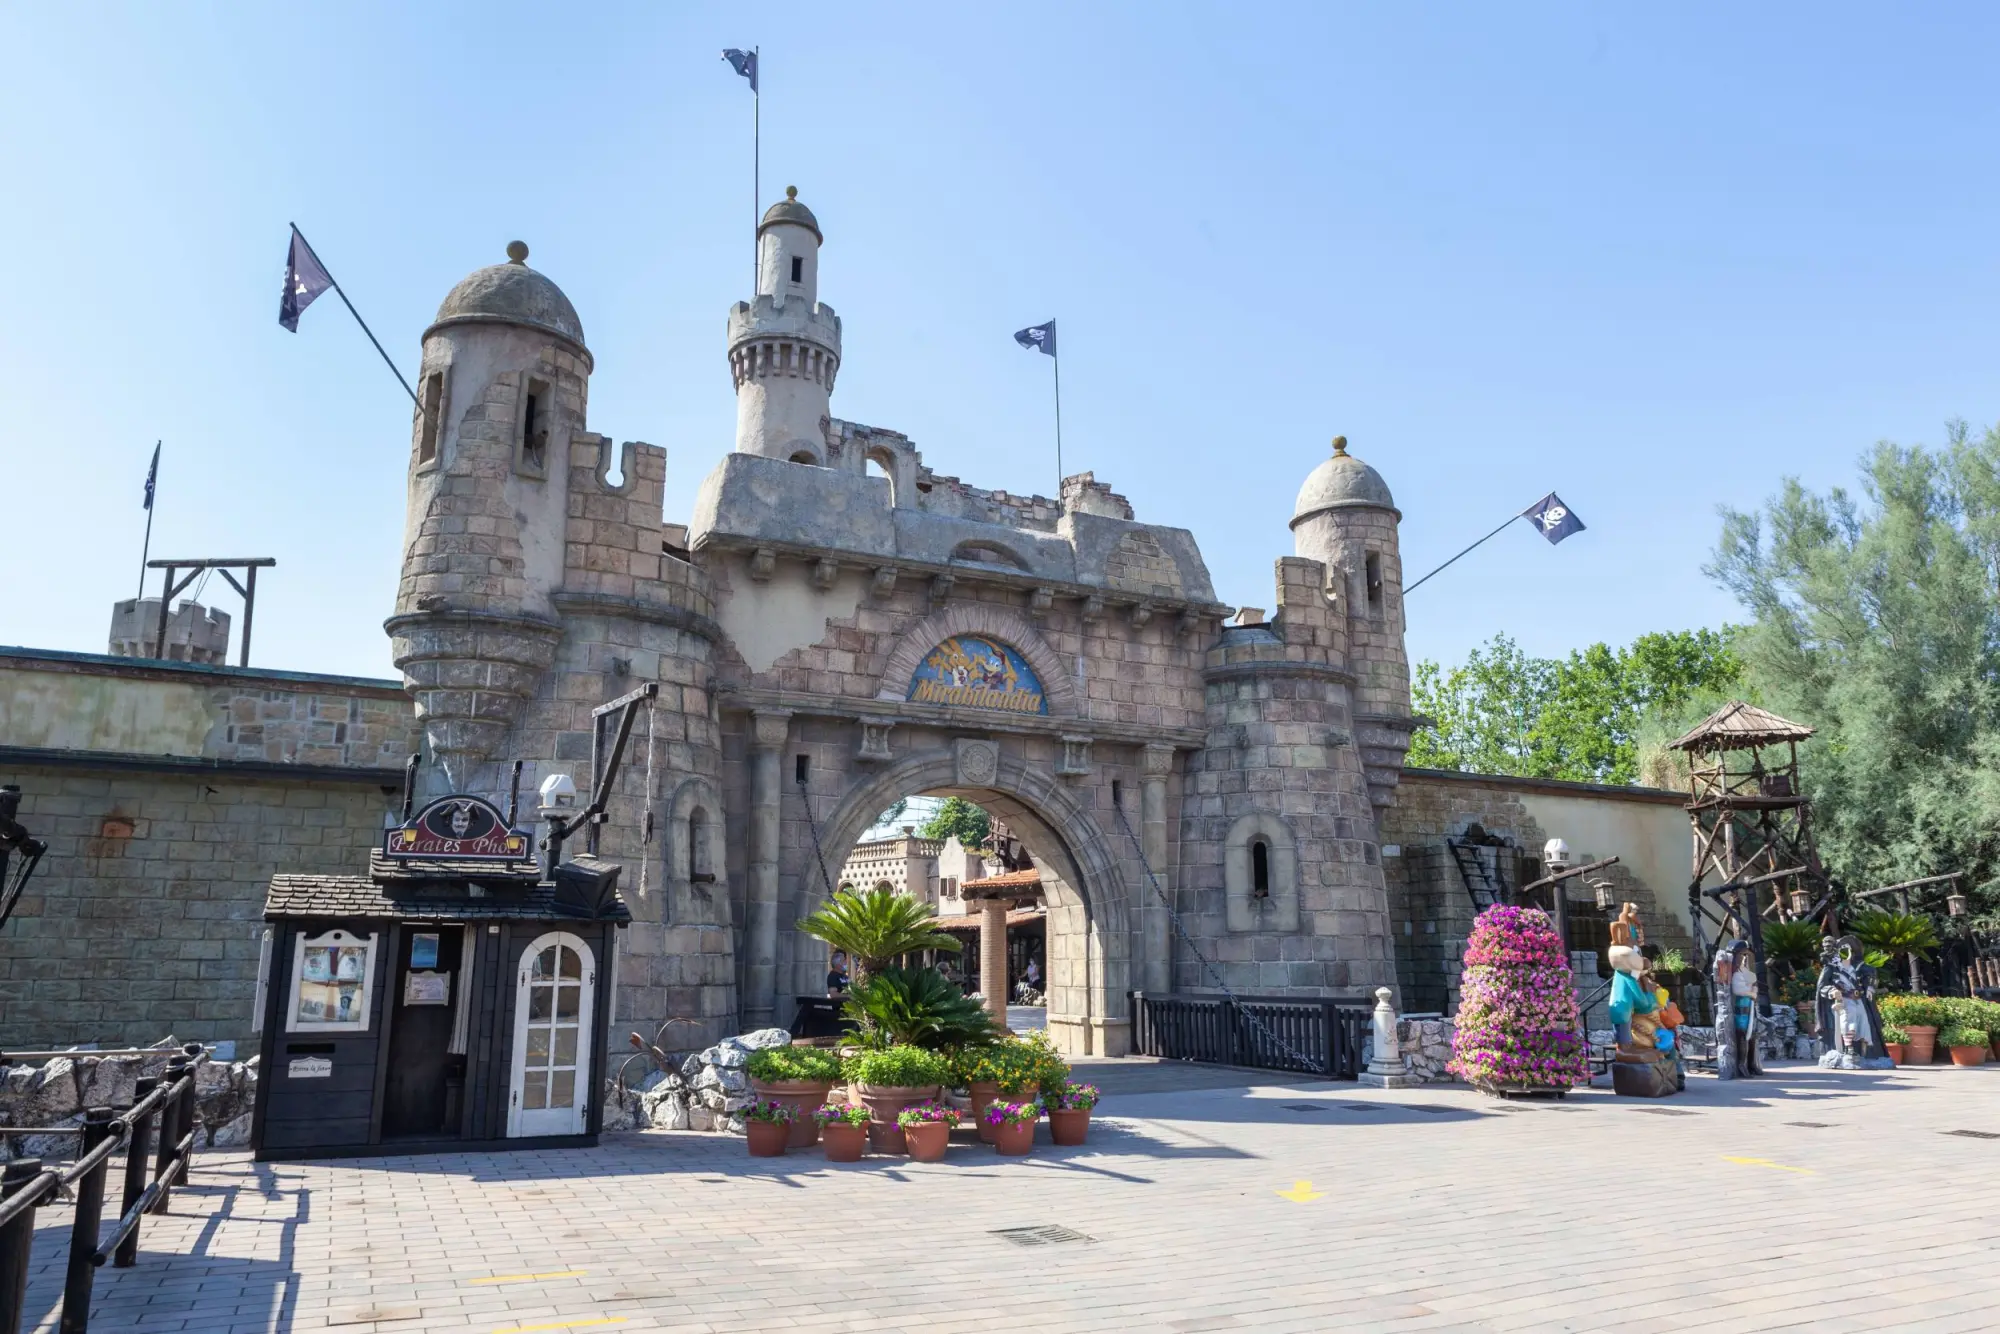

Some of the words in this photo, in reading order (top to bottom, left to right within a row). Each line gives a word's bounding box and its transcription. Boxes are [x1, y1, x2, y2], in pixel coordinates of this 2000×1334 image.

[912, 680, 1041, 711] Mirabilandia
[392, 834, 461, 853] Pirates
[472, 835, 523, 854] Phoo
